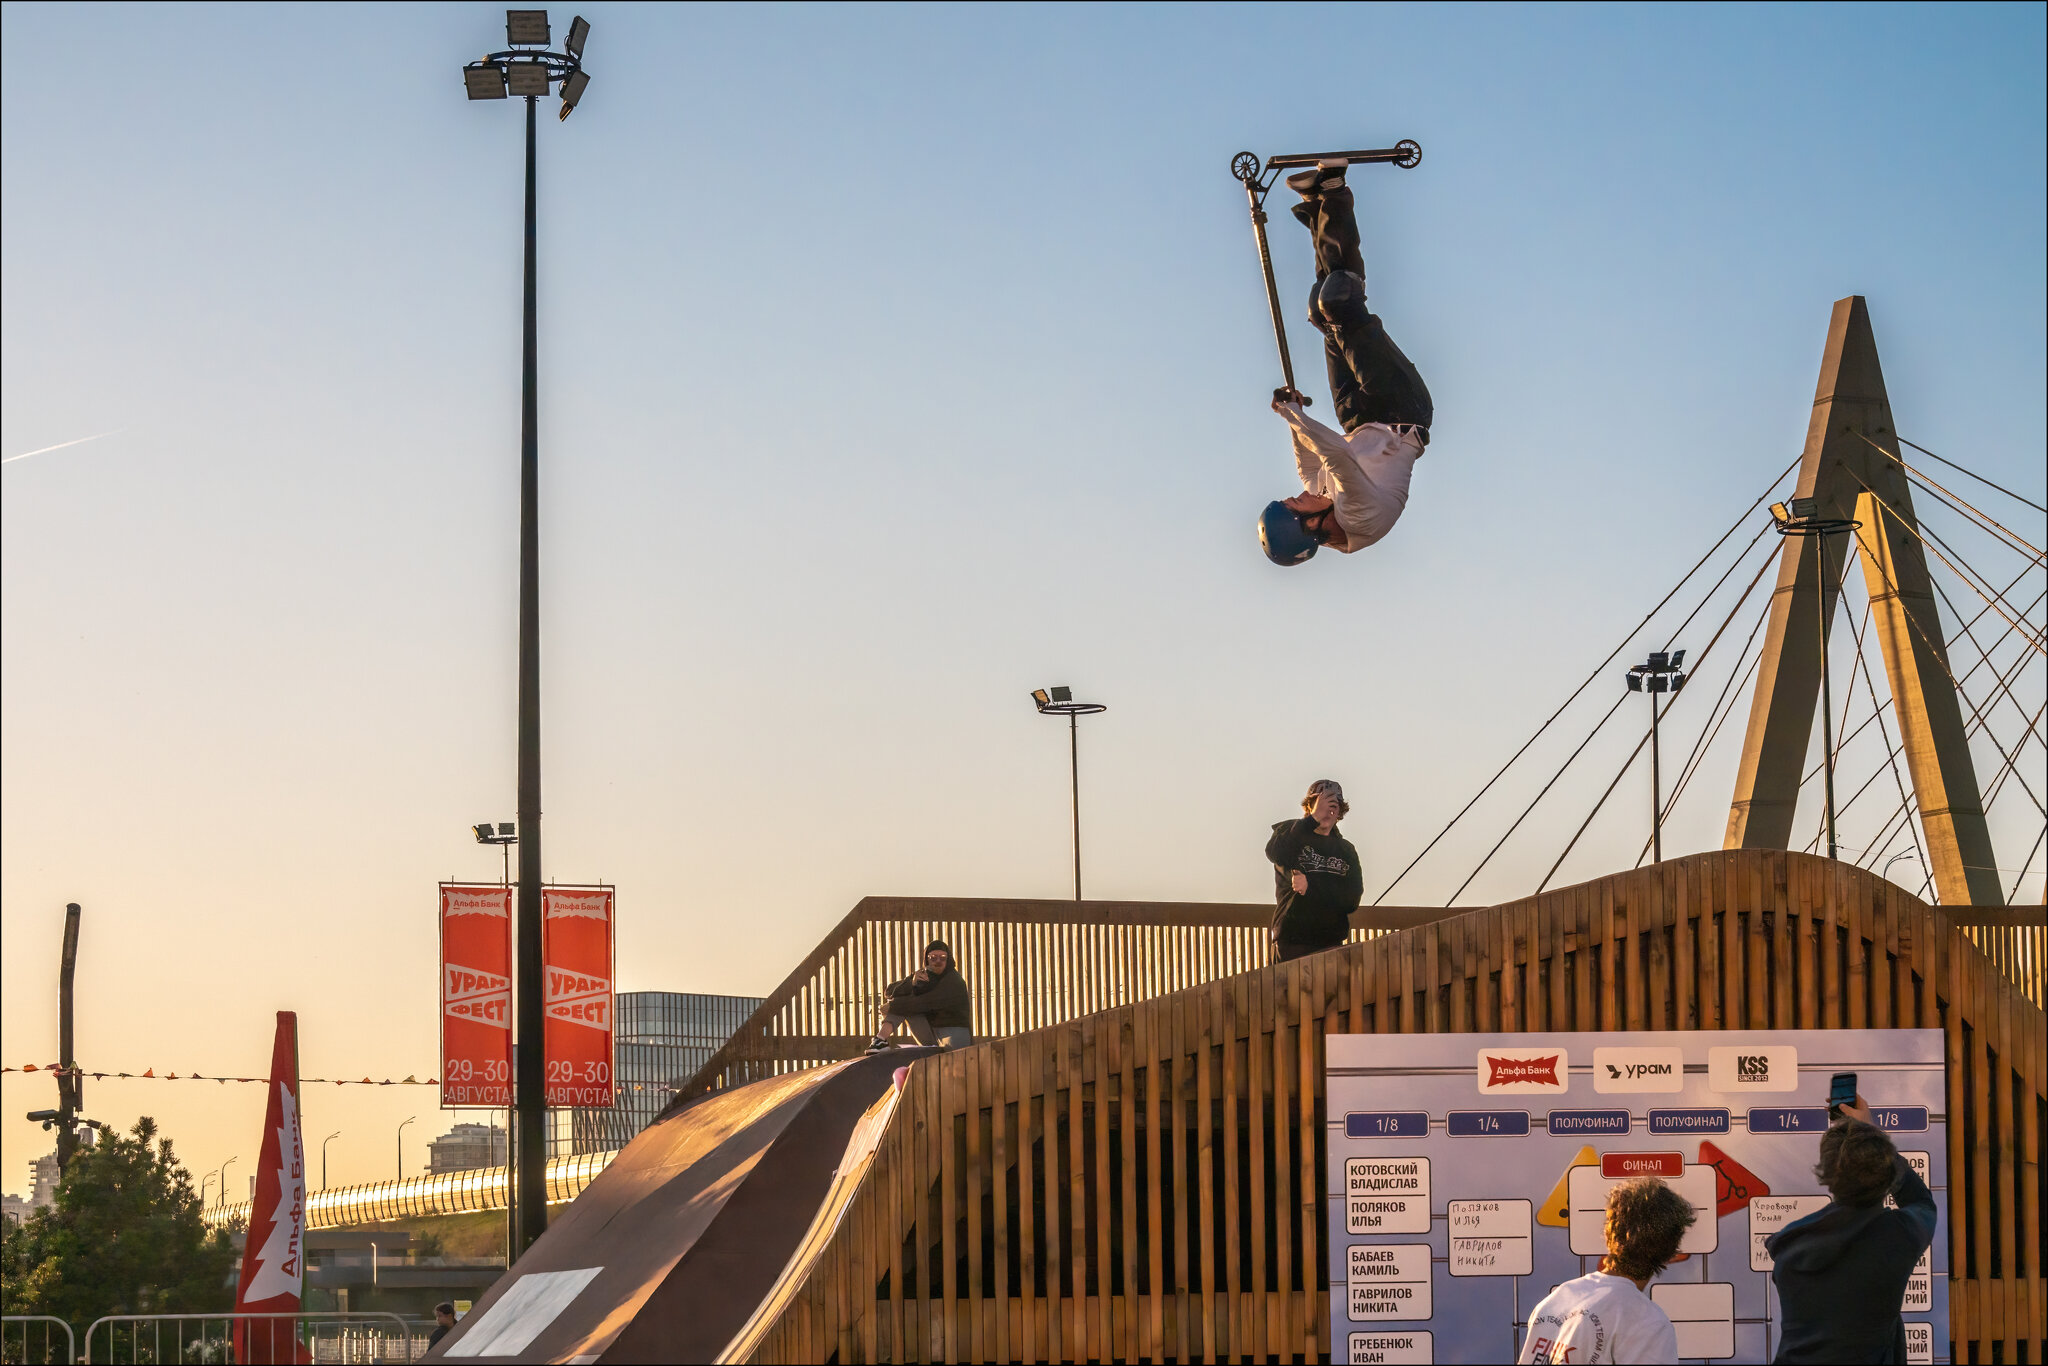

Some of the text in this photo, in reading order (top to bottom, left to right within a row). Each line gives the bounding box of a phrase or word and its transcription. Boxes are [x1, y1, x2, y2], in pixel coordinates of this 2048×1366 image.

[453, 900, 501, 909] Альфа Банк
[554, 903, 601, 912] Альфа Банк
[450, 970, 506, 994] УРАМ
[550, 972, 606, 996] УРАМ
[451, 999, 507, 1022] ФЕСТ
[551, 1001, 607, 1024] ФЕСТ
[1496, 1066, 1551, 1078] Альфа Банк
[1626, 1064, 1672, 1079] урам
[1737, 1056, 1768, 1075] KSS
[447, 1086, 512, 1104] АВГУСТА
[547, 1087, 611, 1105] АВГУСТА
[1376, 1118, 1398, 1133] 1/8
[1478, 1116, 1499, 1131] 1/4
[1555, 1117, 1623, 1129] ПОЛУФИНАЛ
[1655, 1116, 1723, 1127] ПОЛУФИНАЛ
[1779, 1114, 1800, 1128] 1/4
[1877, 1112, 1899, 1127] 1/8
[1350, 1162, 1418, 1176] КОТОВСКИЙ
[1623, 1160, 1662, 1171] ФИНАЛ
[1351, 1178, 1418, 1191] ВЛАДИСЛАВ
[1352, 1202, 1406, 1213] ПОЛЯКОВ
[1352, 1216, 1382, 1227] ИЛЬЯ
[281, 1186, 303, 1278] Альфа
[1352, 1251, 1394, 1262] БАБАЕВ
[1352, 1265, 1399, 1276] КАМИЛЬ
[1353, 1289, 1412, 1300] ГАВРИЛОВ
[1353, 1302, 1398, 1313] НИКИТА
[1353, 1338, 1413, 1349] ГРЕБЕНЮК
[1354, 1352, 1384, 1363] ИВАН
